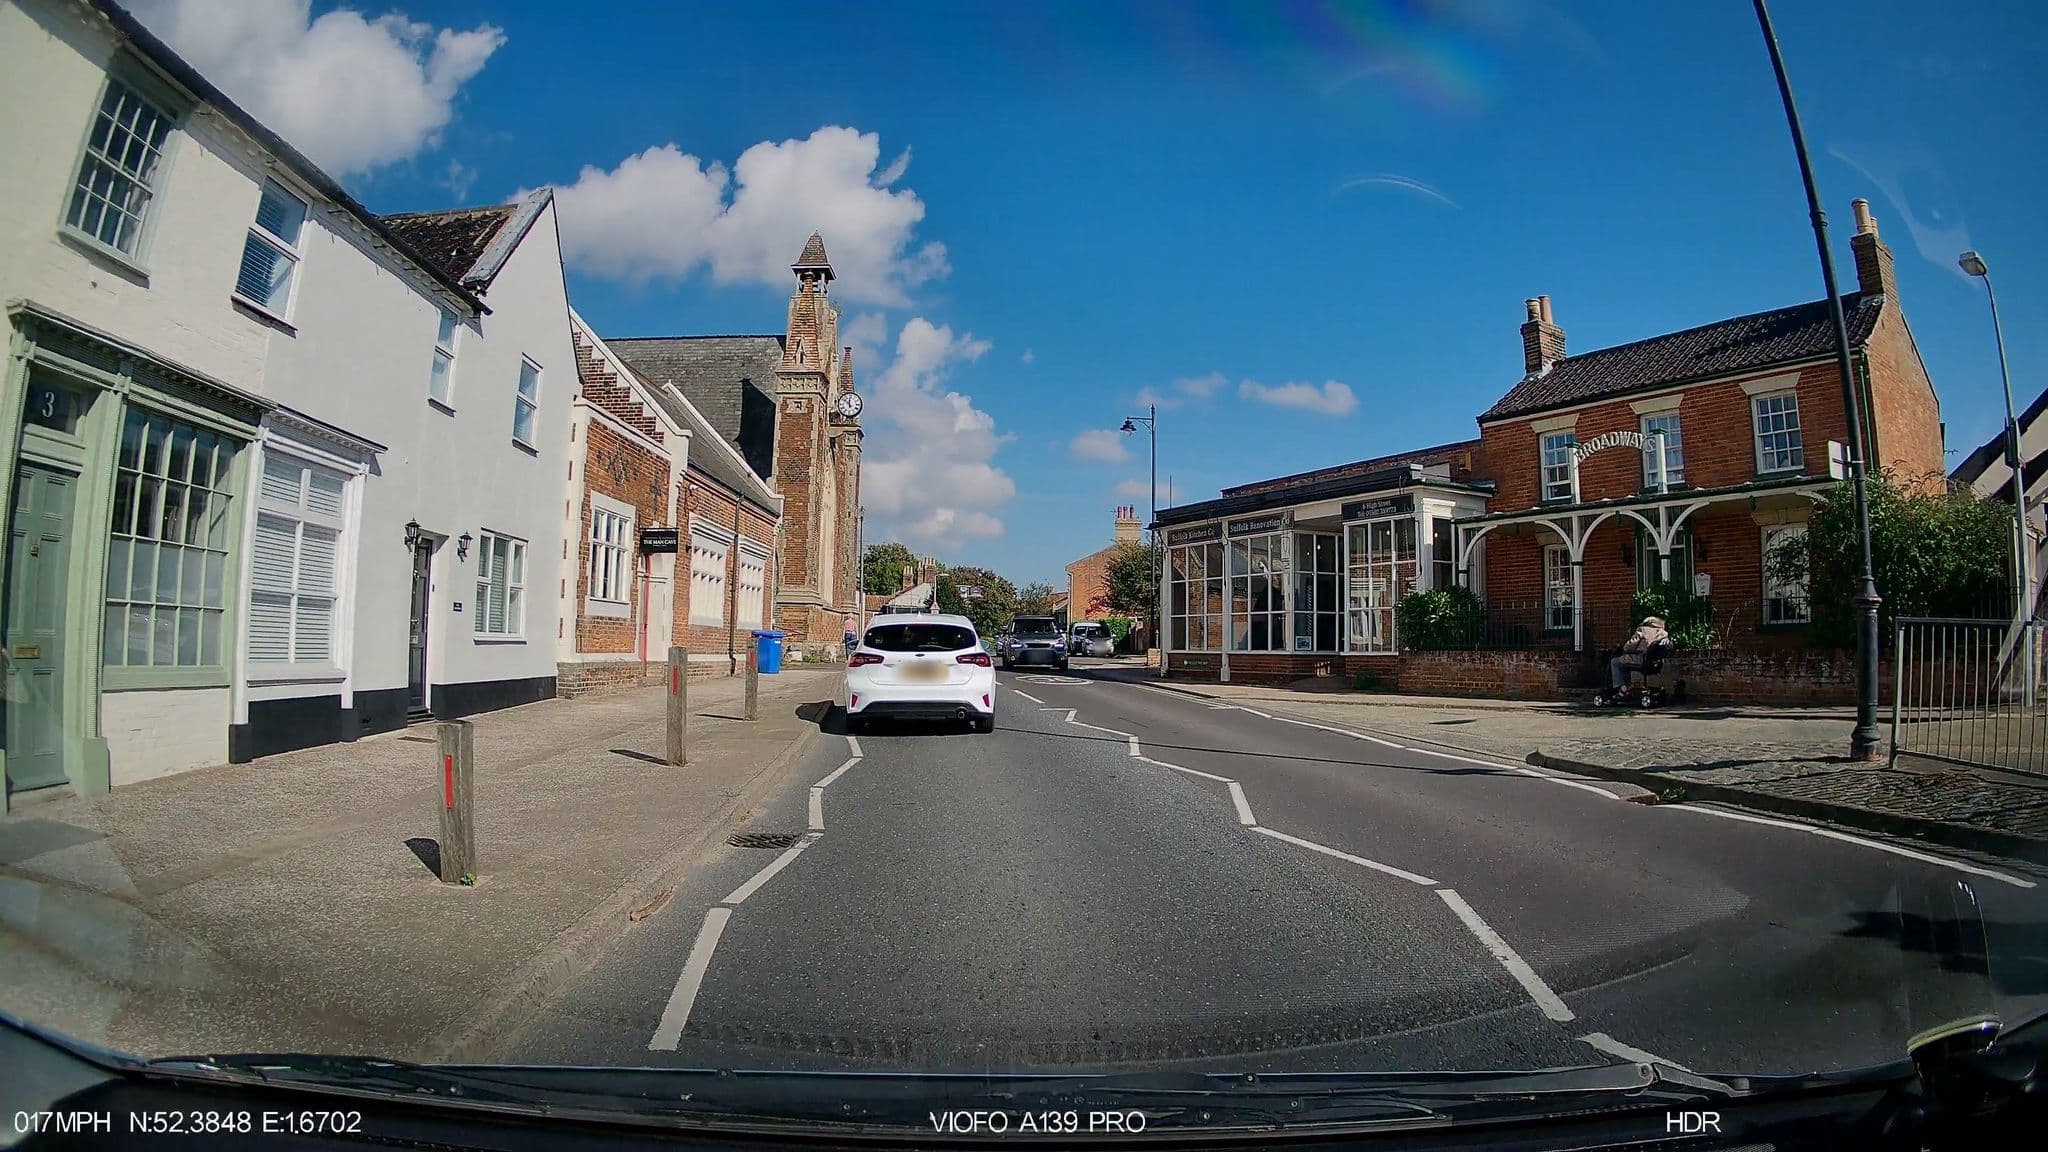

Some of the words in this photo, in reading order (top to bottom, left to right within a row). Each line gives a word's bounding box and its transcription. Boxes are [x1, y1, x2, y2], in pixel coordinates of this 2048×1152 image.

[42, 391, 55, 418] 3
[1574, 431, 1656, 462] BROADWAYS
[1229, 522, 1249, 533] Suffolk
[1250, 518, 1281, 530] Renovation
